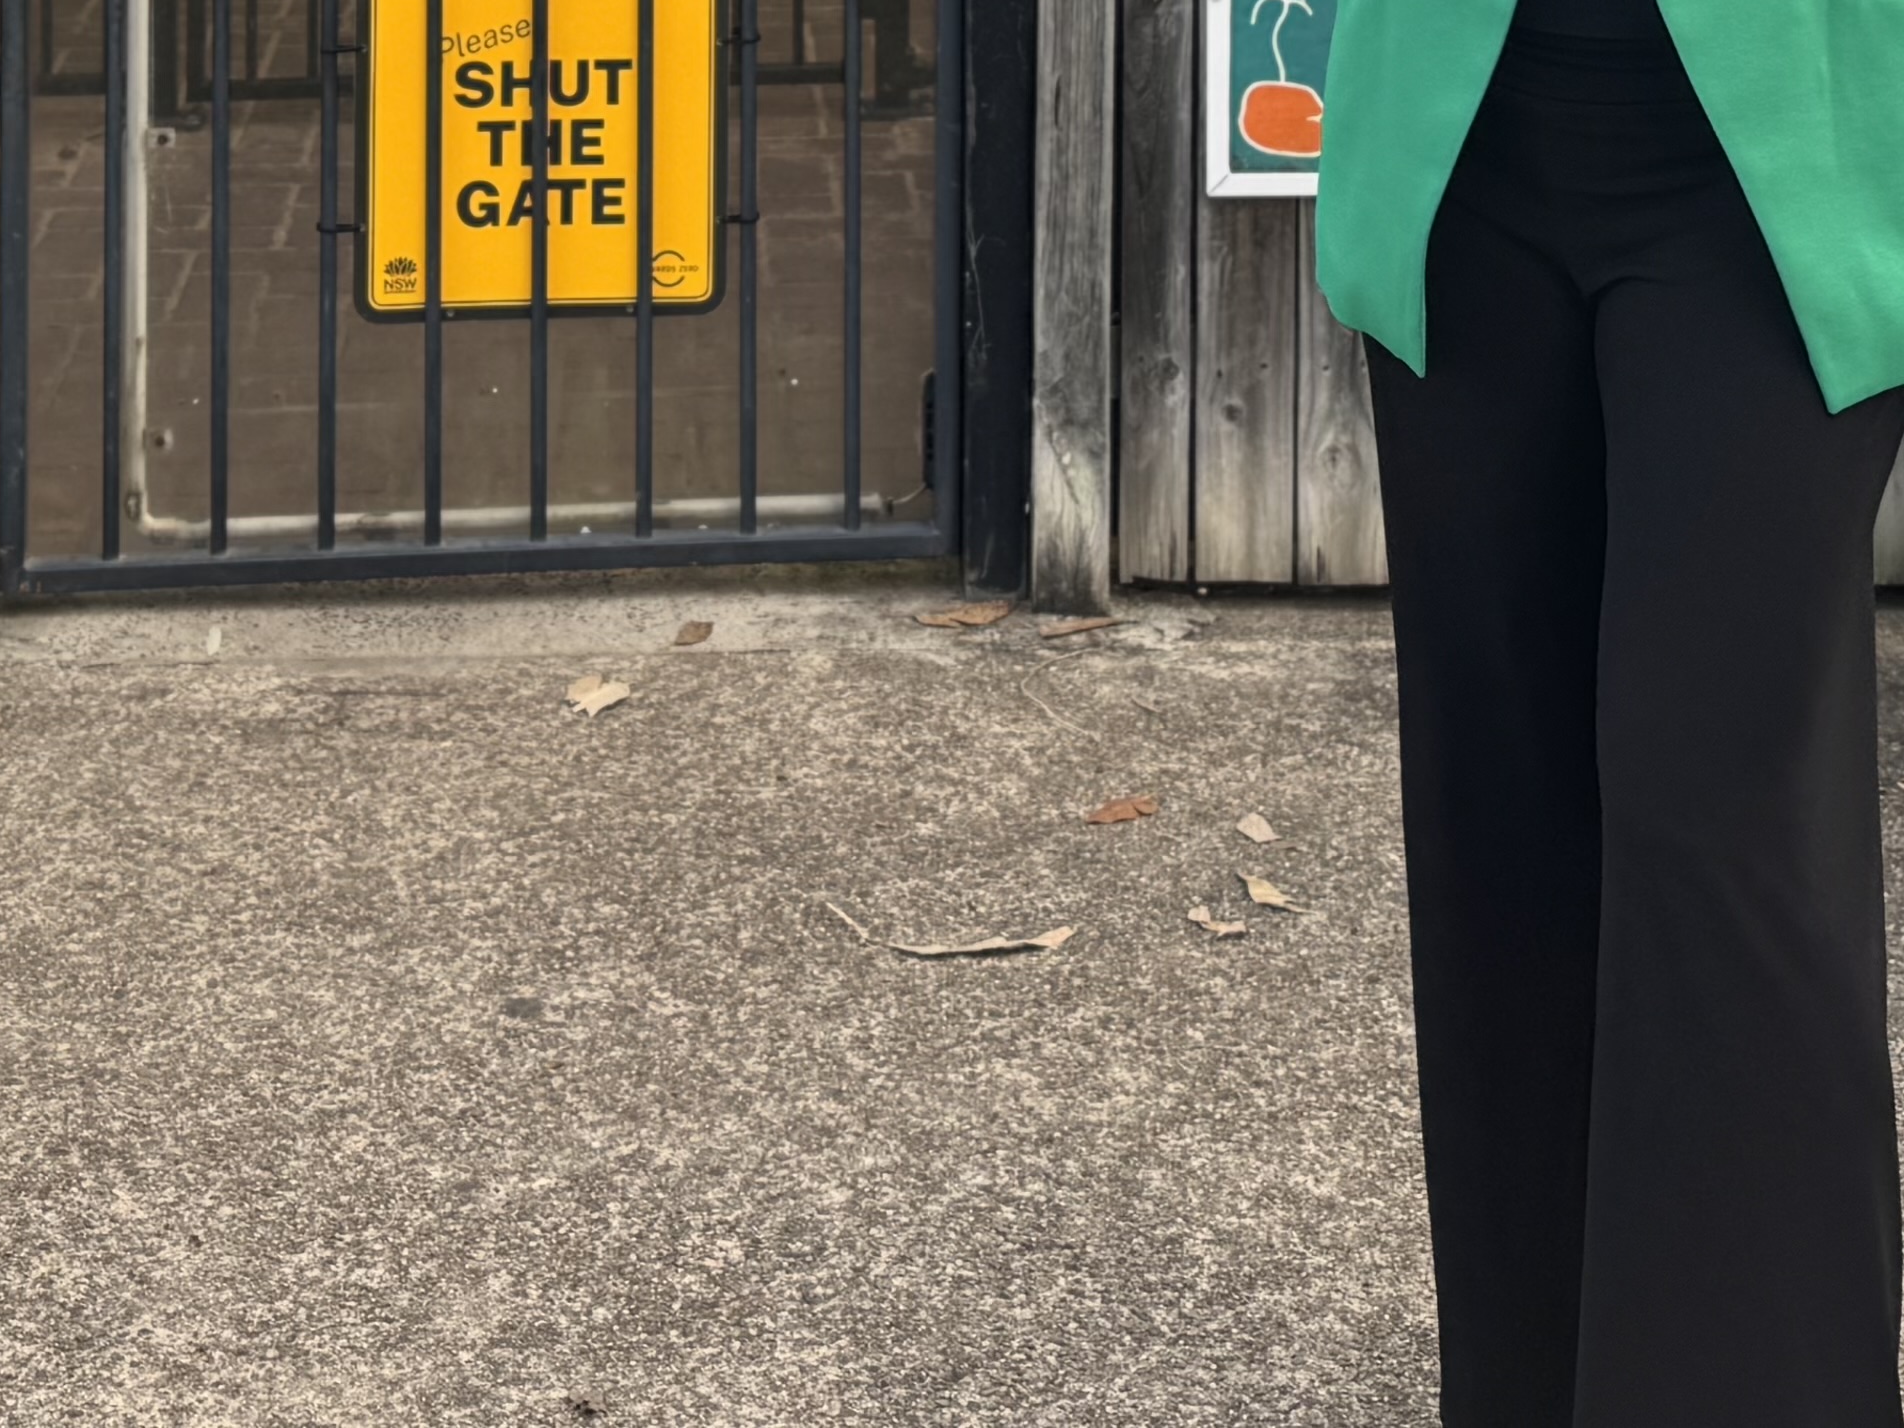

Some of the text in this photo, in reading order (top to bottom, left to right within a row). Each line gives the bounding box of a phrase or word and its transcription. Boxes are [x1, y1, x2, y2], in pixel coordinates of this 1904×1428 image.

[454, 58, 633, 109] SHUT
[477, 118, 605, 167] THE
[456, 177, 626, 228] GATE
[384, 278, 417, 290] NSW
